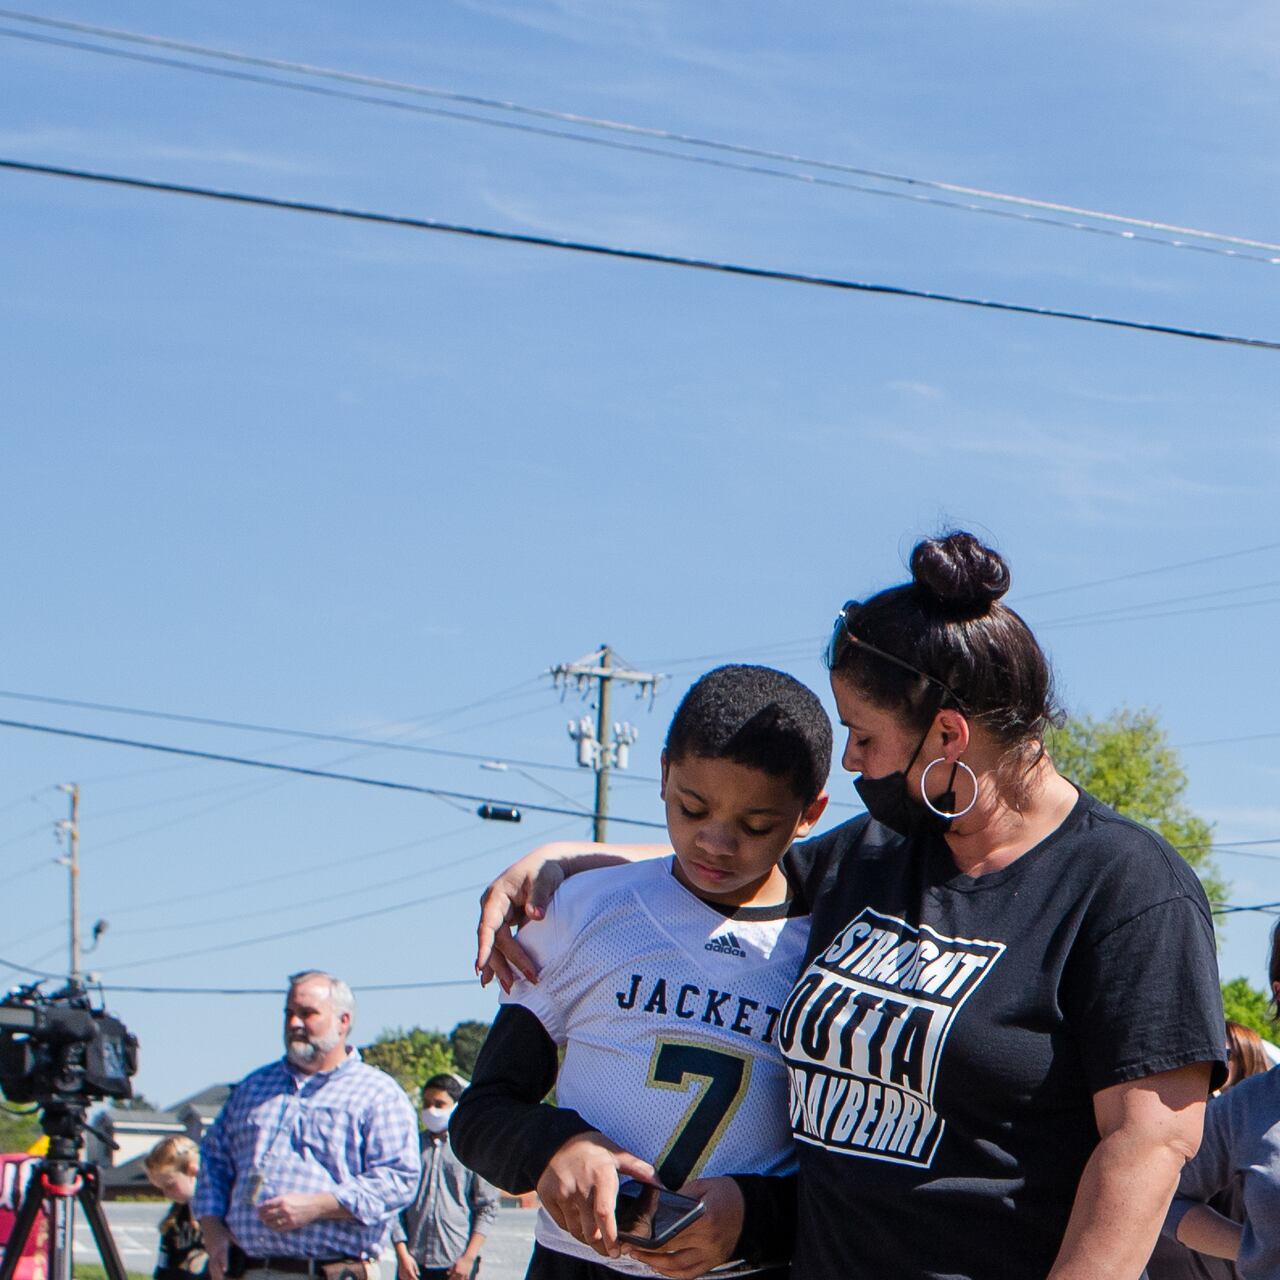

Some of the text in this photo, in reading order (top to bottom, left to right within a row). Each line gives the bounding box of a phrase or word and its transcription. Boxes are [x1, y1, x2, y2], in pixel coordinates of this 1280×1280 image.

[704, 942, 746, 958] adidas
[824, 921, 990, 999] STRAIGHT
[779, 972, 935, 1095] OUTTA
[645, 1034, 754, 1190] 7
